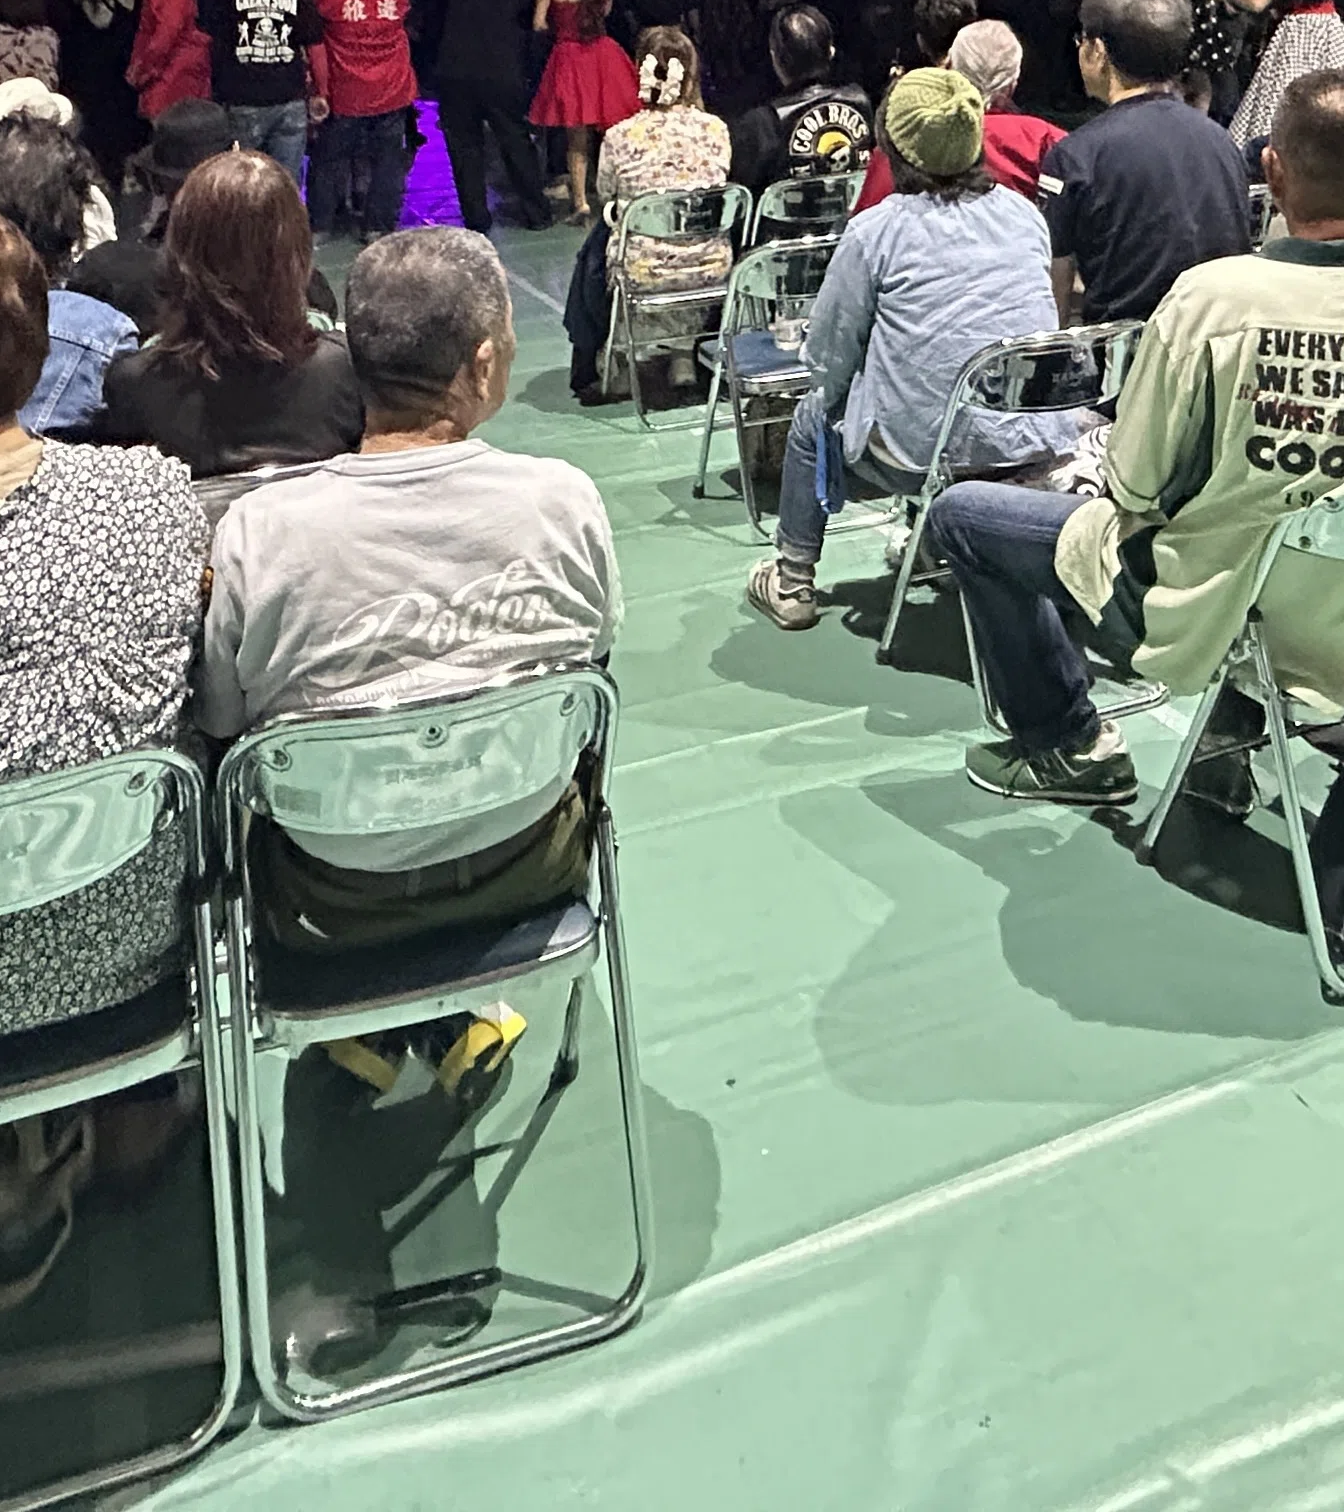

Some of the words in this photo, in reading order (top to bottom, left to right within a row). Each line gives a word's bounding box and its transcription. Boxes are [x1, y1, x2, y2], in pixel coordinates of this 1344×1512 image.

[792, 109, 828, 152] COOL
[828, 104, 869, 139] BROS
[1256, 363, 1304, 397] WE
